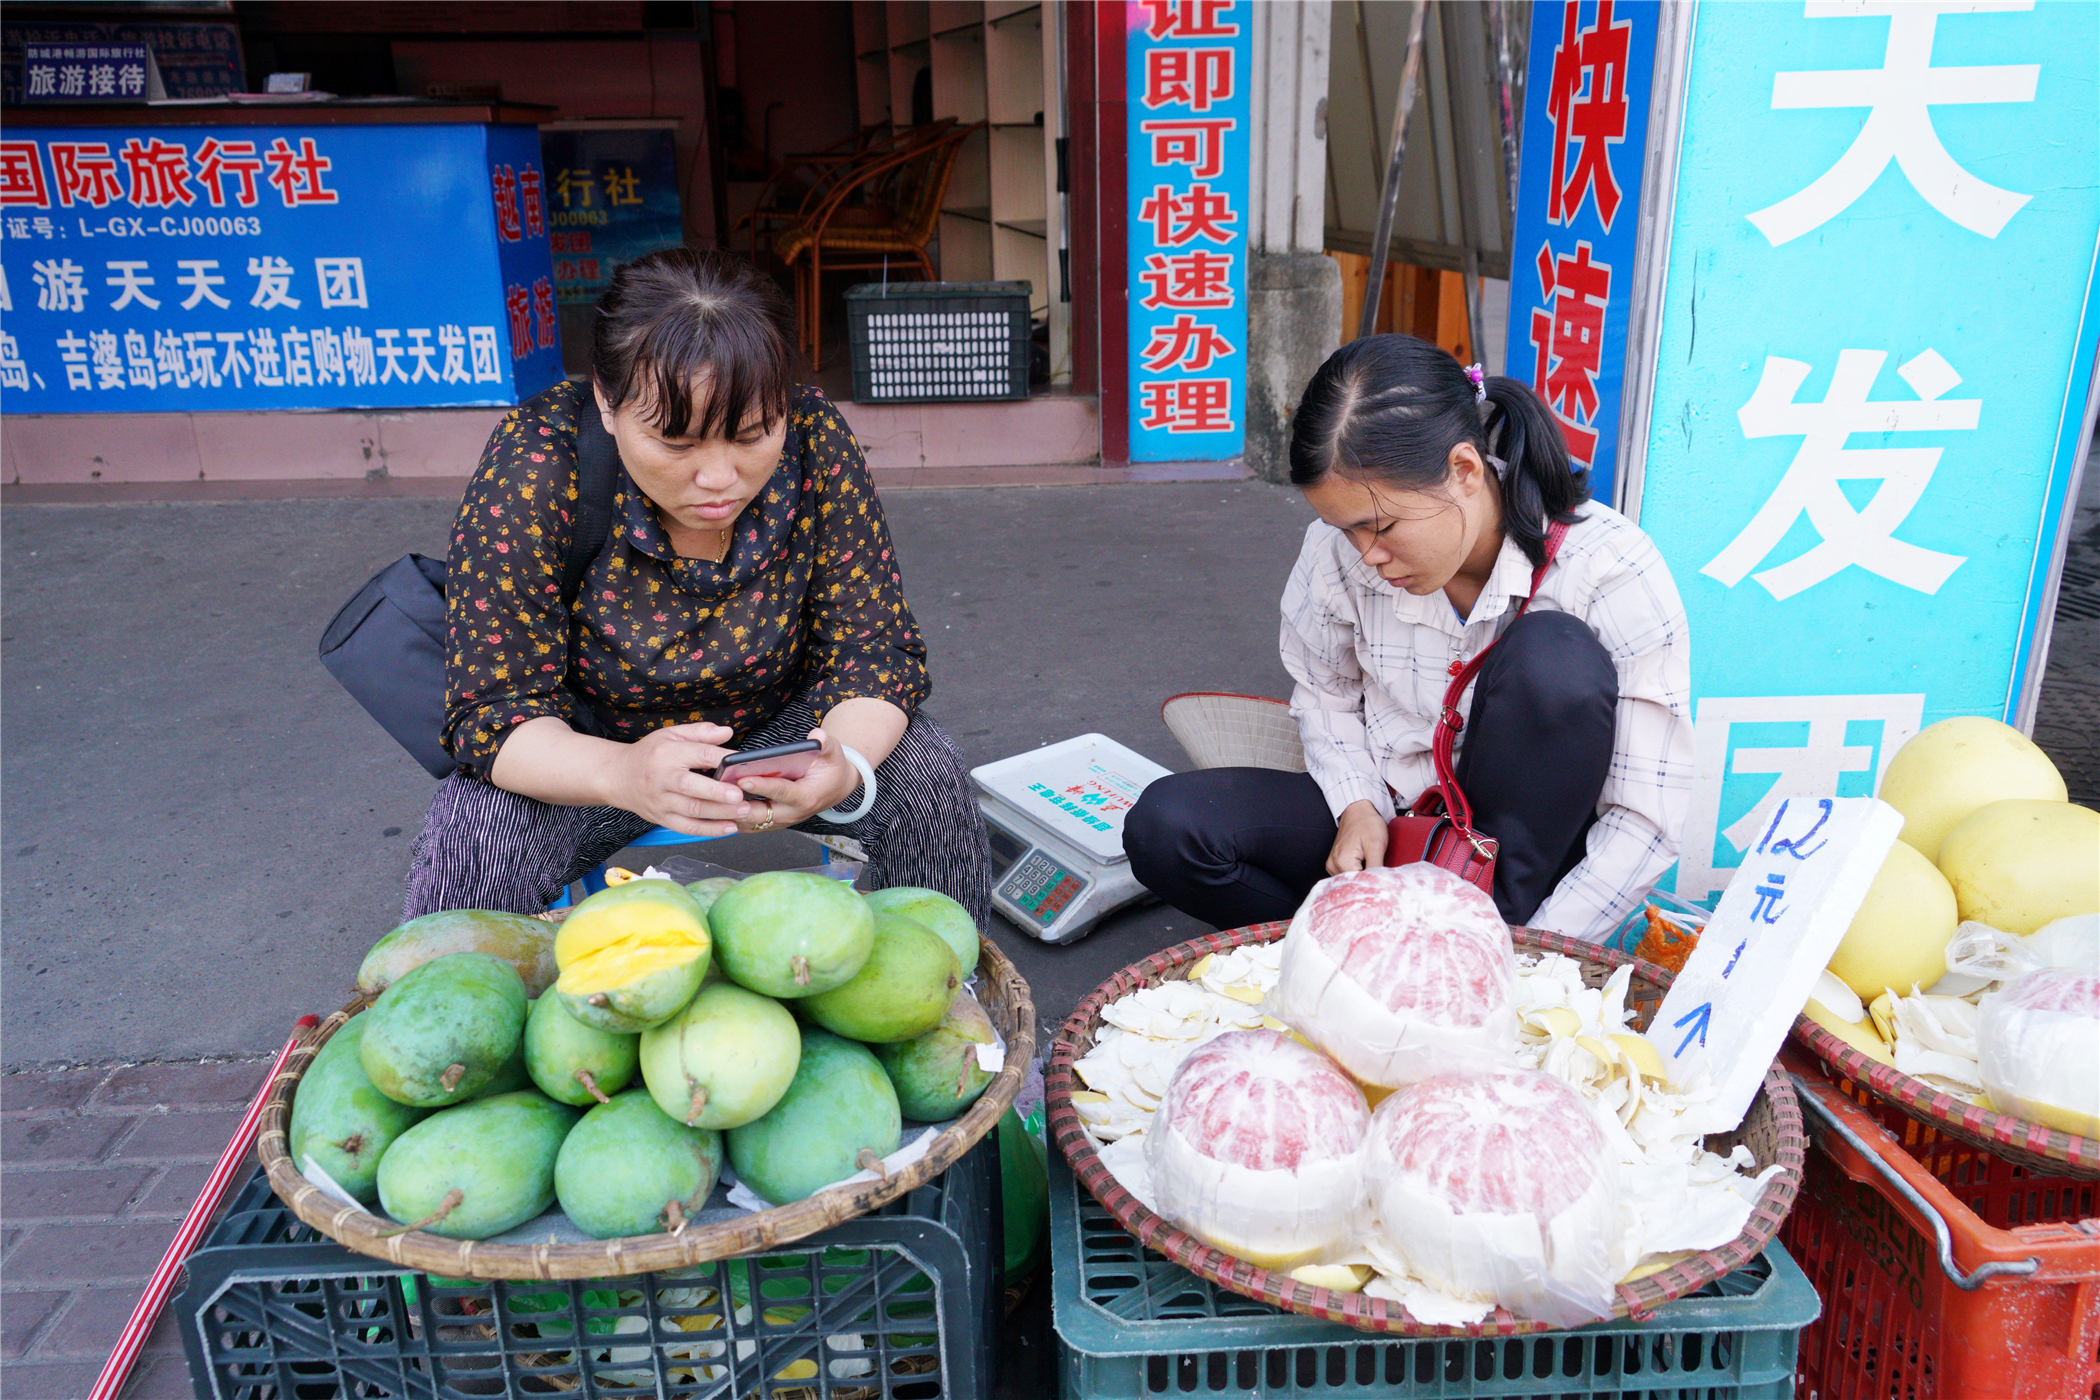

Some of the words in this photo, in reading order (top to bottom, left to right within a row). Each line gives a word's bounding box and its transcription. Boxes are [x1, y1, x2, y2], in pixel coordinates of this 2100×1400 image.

[29, 63, 145, 96] 旅游接待
[0, 136, 339, 209] 国际旅行社
[493, 163, 545, 243] 越南
[556, 167, 644, 207] 行社
[1137, 0, 1240, 434] 证即可快速办理
[1529, 0, 1633, 470] 快速
[0, 256, 369, 313] 游天天发团
[507, 276, 556, 362] 旅游
[1756, 798, 1833, 861] 12
